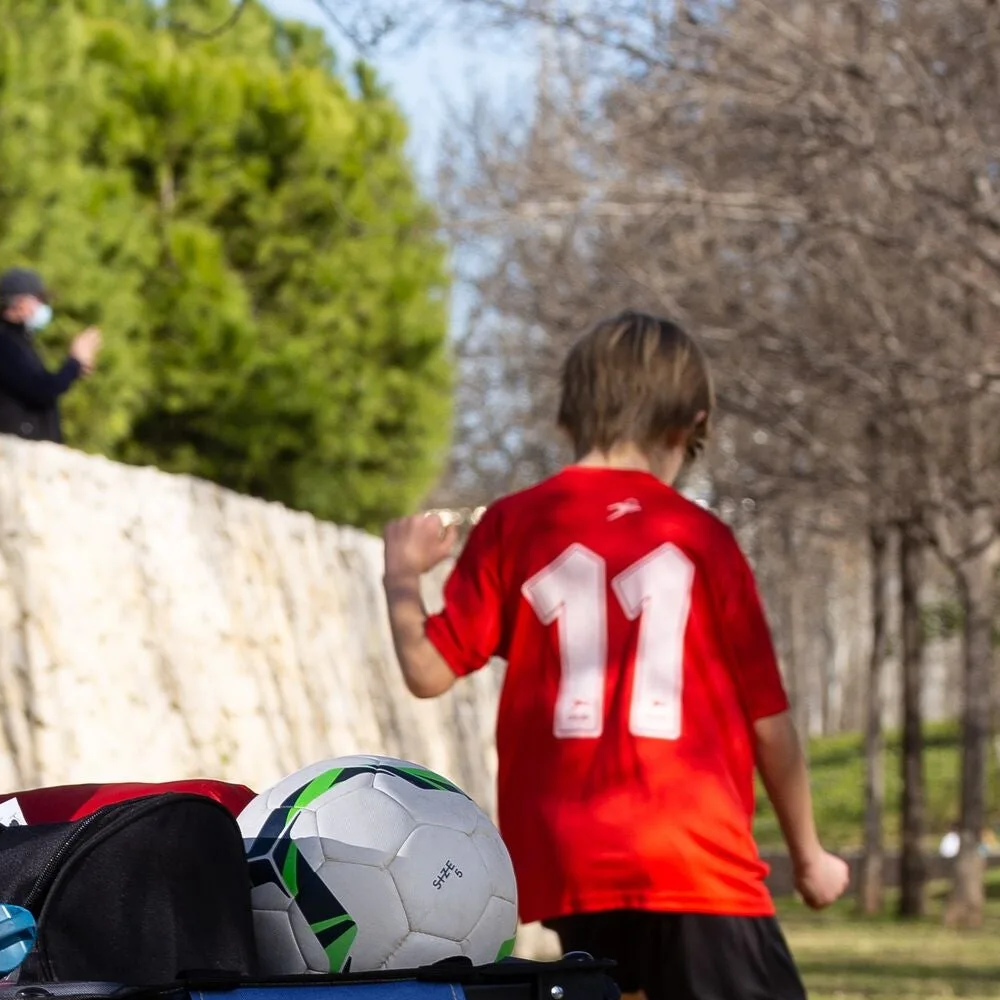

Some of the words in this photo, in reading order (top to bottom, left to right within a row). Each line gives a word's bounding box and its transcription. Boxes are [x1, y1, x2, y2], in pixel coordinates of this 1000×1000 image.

[521, 541, 695, 740] 11
[432, 860, 455, 890] SIZE
[454, 868, 463, 878] 5
